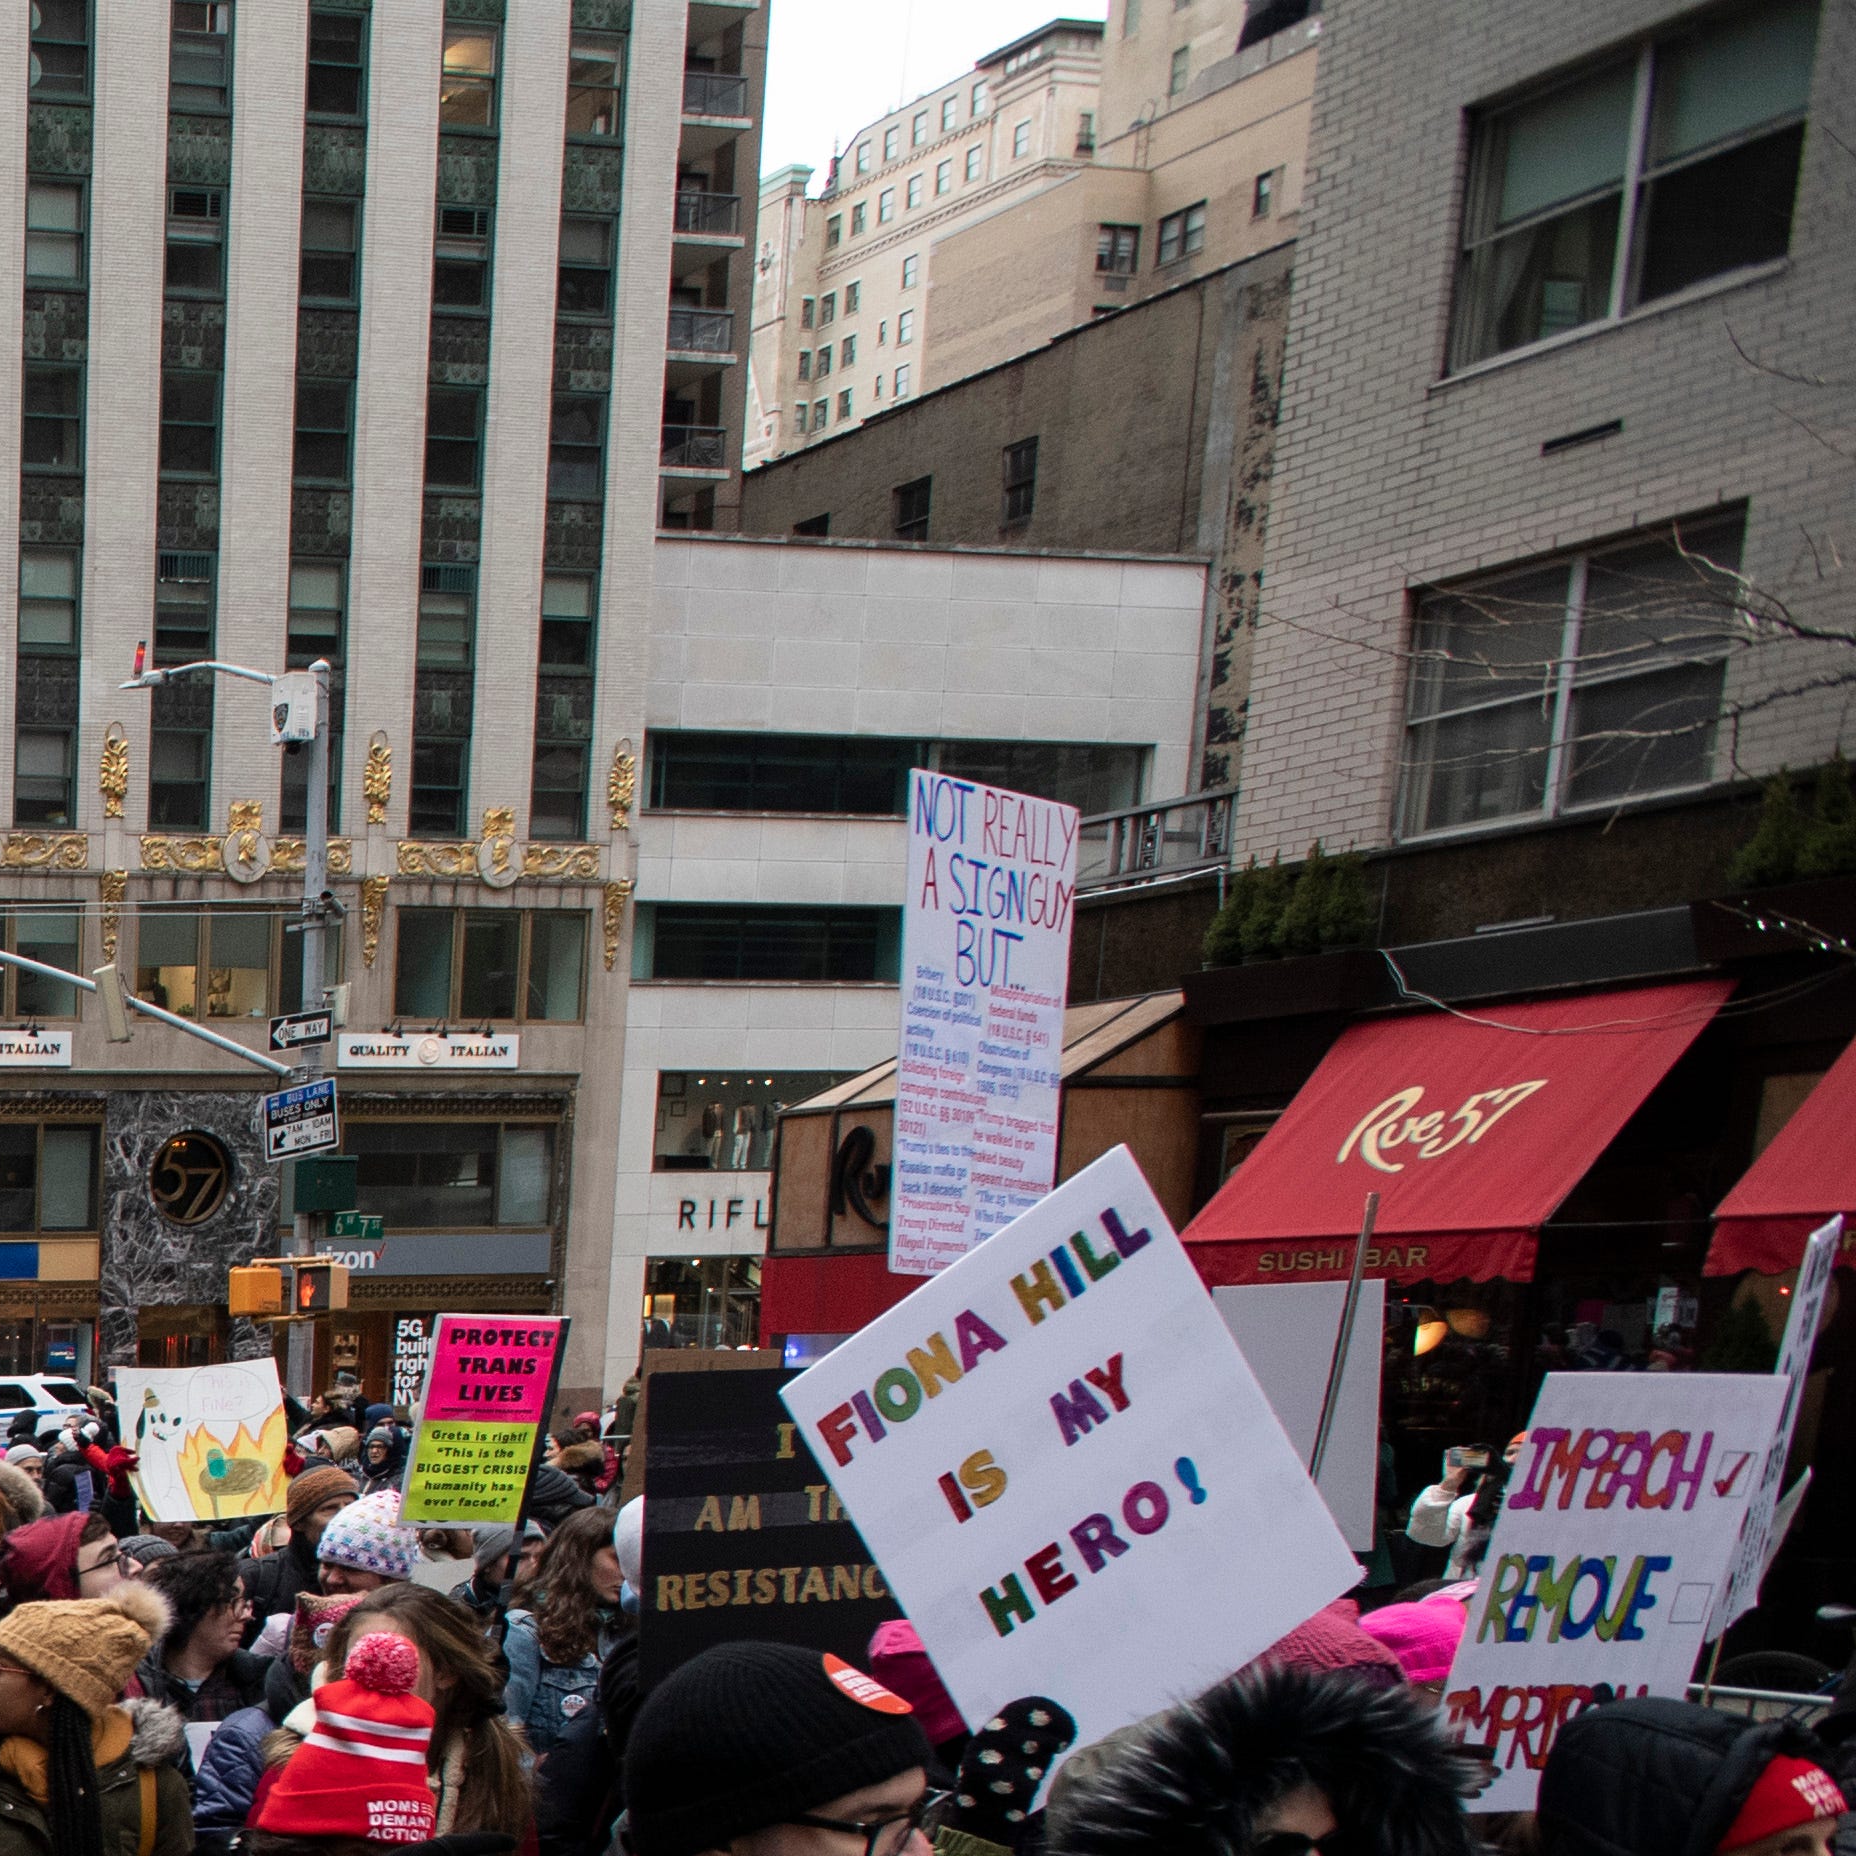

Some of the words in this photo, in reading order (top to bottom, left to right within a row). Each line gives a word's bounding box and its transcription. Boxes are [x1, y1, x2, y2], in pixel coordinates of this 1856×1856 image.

[915, 776, 975, 845] NOT
[983, 790, 1081, 872] REALLY
[921, 847, 939, 910] A
[278, 1026, 296, 1042] ONE
[304, 1021, 324, 1036] WAY
[349, 1045, 410, 1057] QUALITY
[450, 1045, 509, 1058] ITALIAN
[306, 1083, 330, 1098] LANE
[270, 1103, 302, 1121] BUSES
[304, 1096, 329, 1113] ONLY
[335, 1217, 343, 1235] 6
[1258, 1250, 1344, 1273] SUSHI
[1362, 1245, 1429, 1269] BAR
[396, 1319, 424, 1338] 5G
[450, 1328, 556, 1348] PROTECT
[814, 1308, 1009, 1468] FIONA
[1008, 1205, 1153, 1328] HILL
[457, 1356, 538, 1375] TRANS
[393, 1372, 421, 1389] for
[458, 1384, 525, 1402] LIVES
[431, 1429, 470, 1442] Greta
[474, 1431, 488, 1442] is
[937, 1448, 1009, 1525] IS
[1048, 1351, 1132, 1448] MY
[478, 1448, 490, 1459] is
[494, 1447, 515, 1459] the
[415, 1463, 480, 1475] BIGGEST
[482, 1464, 528, 1476] CRISIS
[1506, 1427, 1714, 1513] IMPEACH
[423, 1480, 487, 1493] humanity
[491, 1481, 514, 1492] has
[423, 1497, 454, 1507] ever
[694, 1495, 762, 1532] AM
[979, 1455, 1209, 1638] HERO!
[366, 1799, 420, 1813] MOMS
[366, 1828, 429, 1842] ACTION
